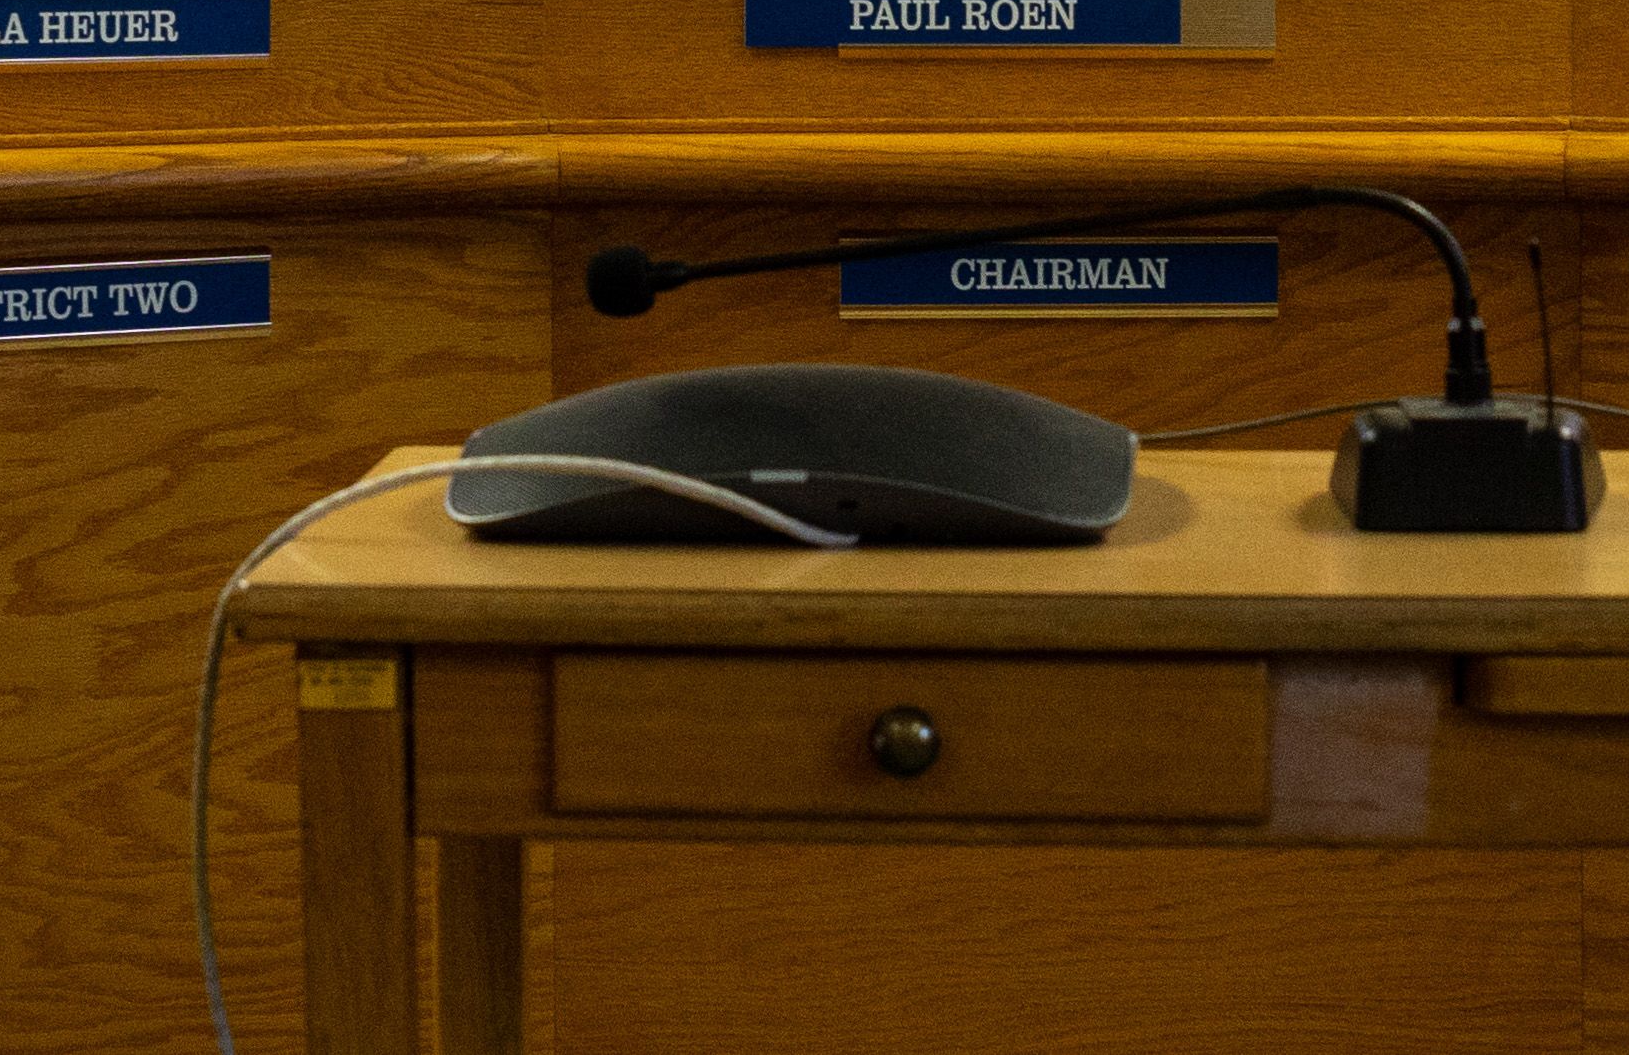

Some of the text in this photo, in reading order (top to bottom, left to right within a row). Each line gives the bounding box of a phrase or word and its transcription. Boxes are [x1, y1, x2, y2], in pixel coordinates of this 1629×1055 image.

[38, 9, 179, 44] HEUER
[950, 258, 1169, 291] CHAIRMAN
[108, 280, 199, 316] TWO
